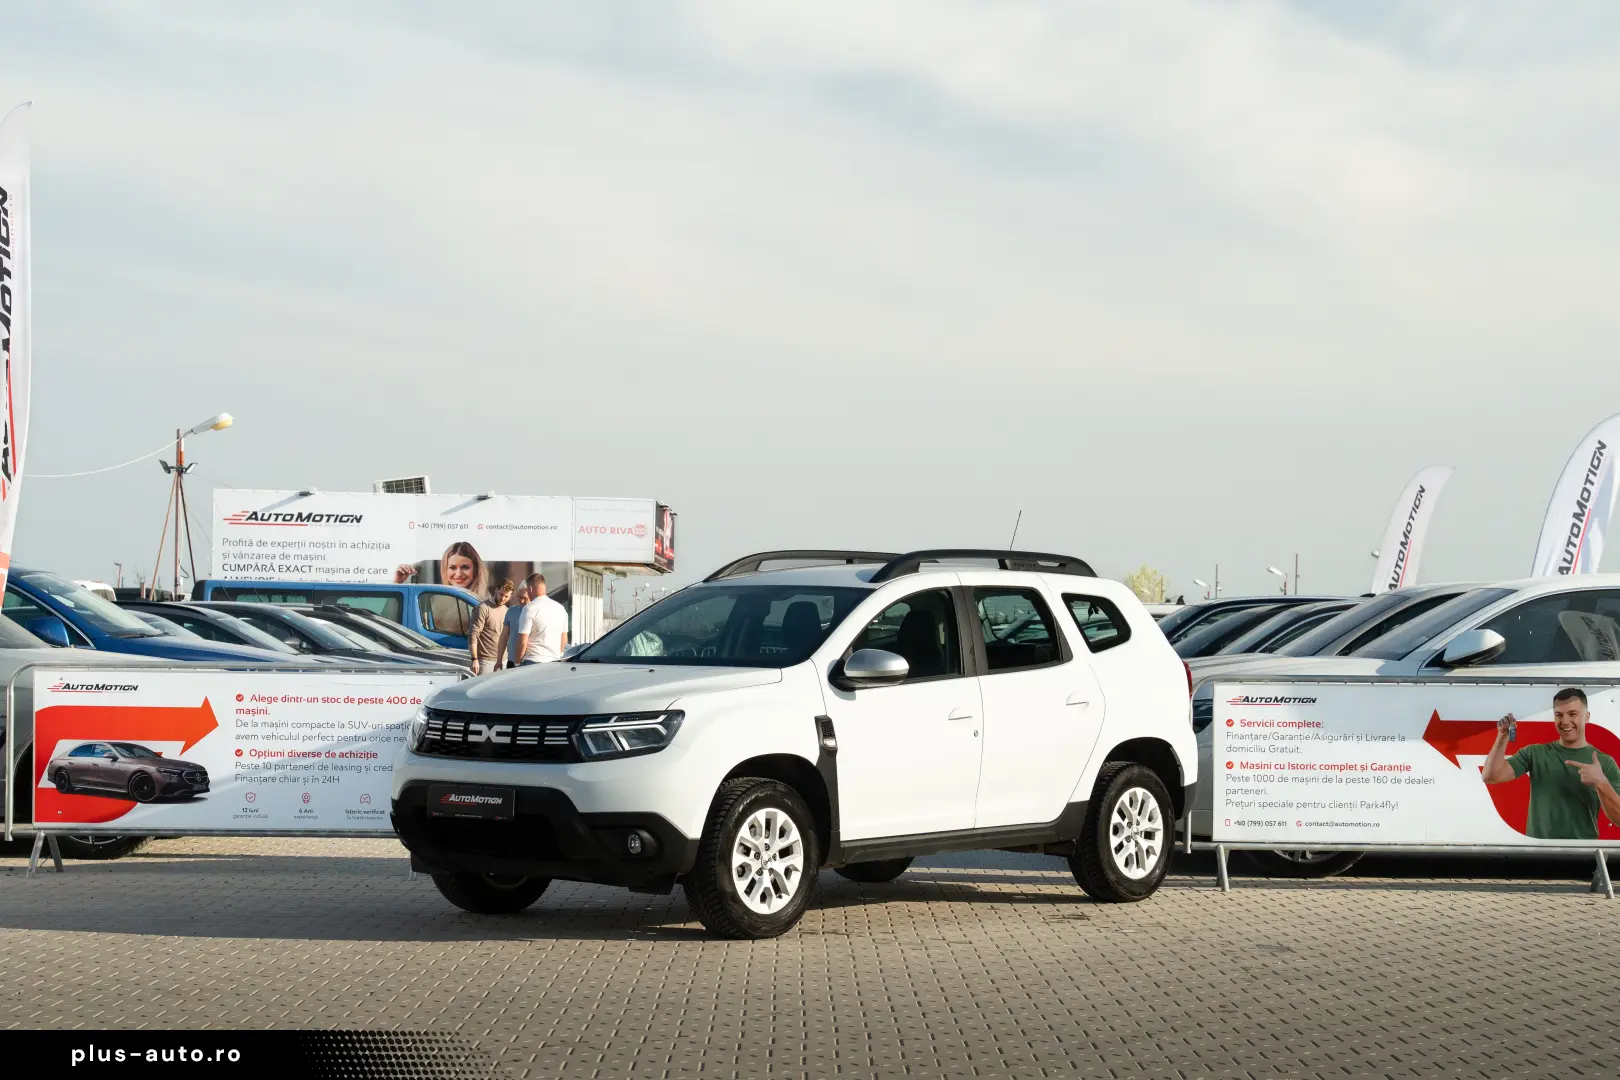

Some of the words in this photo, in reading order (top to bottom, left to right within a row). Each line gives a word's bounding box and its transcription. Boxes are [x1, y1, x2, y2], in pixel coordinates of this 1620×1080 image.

[430, 522, 446, 530] (799)
[578, 526, 607, 534] AUTO
[222, 538, 253, 547] Profită
[256, 538, 267, 548] de
[279, 552, 291, 560] de
[222, 562, 276, 573] CUMPĂRĂ
[278, 565, 313, 574] EXACT
[315, 566, 350, 576] mașina
[353, 566, 365, 574] de
[250, 694, 278, 704] Alege
[281, 695, 319, 704] dintr-un
[321, 696, 342, 704] stoc
[344, 695, 354, 704] de
[357, 697, 384, 706] peste
[386, 696, 407, 704] 400
[410, 696, 422, 705] de
[235, 707, 270, 716] mașini.
[235, 719, 248, 728] De
[251, 719, 258, 728] la
[261, 720, 289, 730] mașini
[291, 721, 335, 731] compacte
[338, 720, 345, 729] la
[348, 721, 383, 730] SUV-uri
[1240, 719, 1274, 728] Servicii
[1277, 720, 1324, 730] complete:
[235, 733, 259, 741] avem
[261, 732, 300, 741] vehiculul
[302, 733, 334, 744] perfect
[337, 734, 367, 744] pentru
[369, 734, 391, 742] orice
[1357, 733, 1363, 743] și
[1365, 734, 1396, 742] Livrare
[1398, 733, 1406, 742] la
[249, 749, 285, 760] Opțiuni
[288, 750, 322, 758] diverse
[325, 750, 336, 759] de
[339, 750, 378, 760] achiziție
[1226, 744, 1266, 753] domiciliu
[1269, 746, 1302, 754] Gratuit.
[235, 762, 259, 770] Peste
[262, 762, 272, 770] 10
[274, 763, 315, 773] parteneri
[318, 762, 329, 771] de
[331, 762, 362, 773] leasing
[364, 764, 371, 774] și
[1288, 762, 1317, 771] Istoric
[1319, 762, 1358, 773] complet
[1360, 762, 1368, 773] și
[1370, 763, 1412, 774] Garanție
[234, 775, 276, 785] Finanțare
[279, 775, 300, 783] chiar
[303, 775, 308, 785] și
[311, 775, 320, 783] în
[322, 776, 340, 784] 24H
[1226, 774, 1250, 783] Peste
[1252, 774, 1275, 783] 1000
[1277, 774, 1289, 783] de
[1291, 775, 1320, 785] mașini
[1322, 775, 1333, 784] de
[1336, 775, 1343, 784] la
[1346, 776, 1370, 786] peste
[1373, 776, 1388, 784] 160
[1390, 775, 1402, 784] de
[1405, 776, 1435, 785] dealeri
[1226, 787, 1269, 797] parteneri.
[1226, 799, 1255, 809] Prețuri
[1258, 800, 1294, 810] speciale
[1296, 801, 1326, 811] pentru
[1328, 800, 1357, 811] clienții
[1360, 801, 1399, 811] Park4fly!
